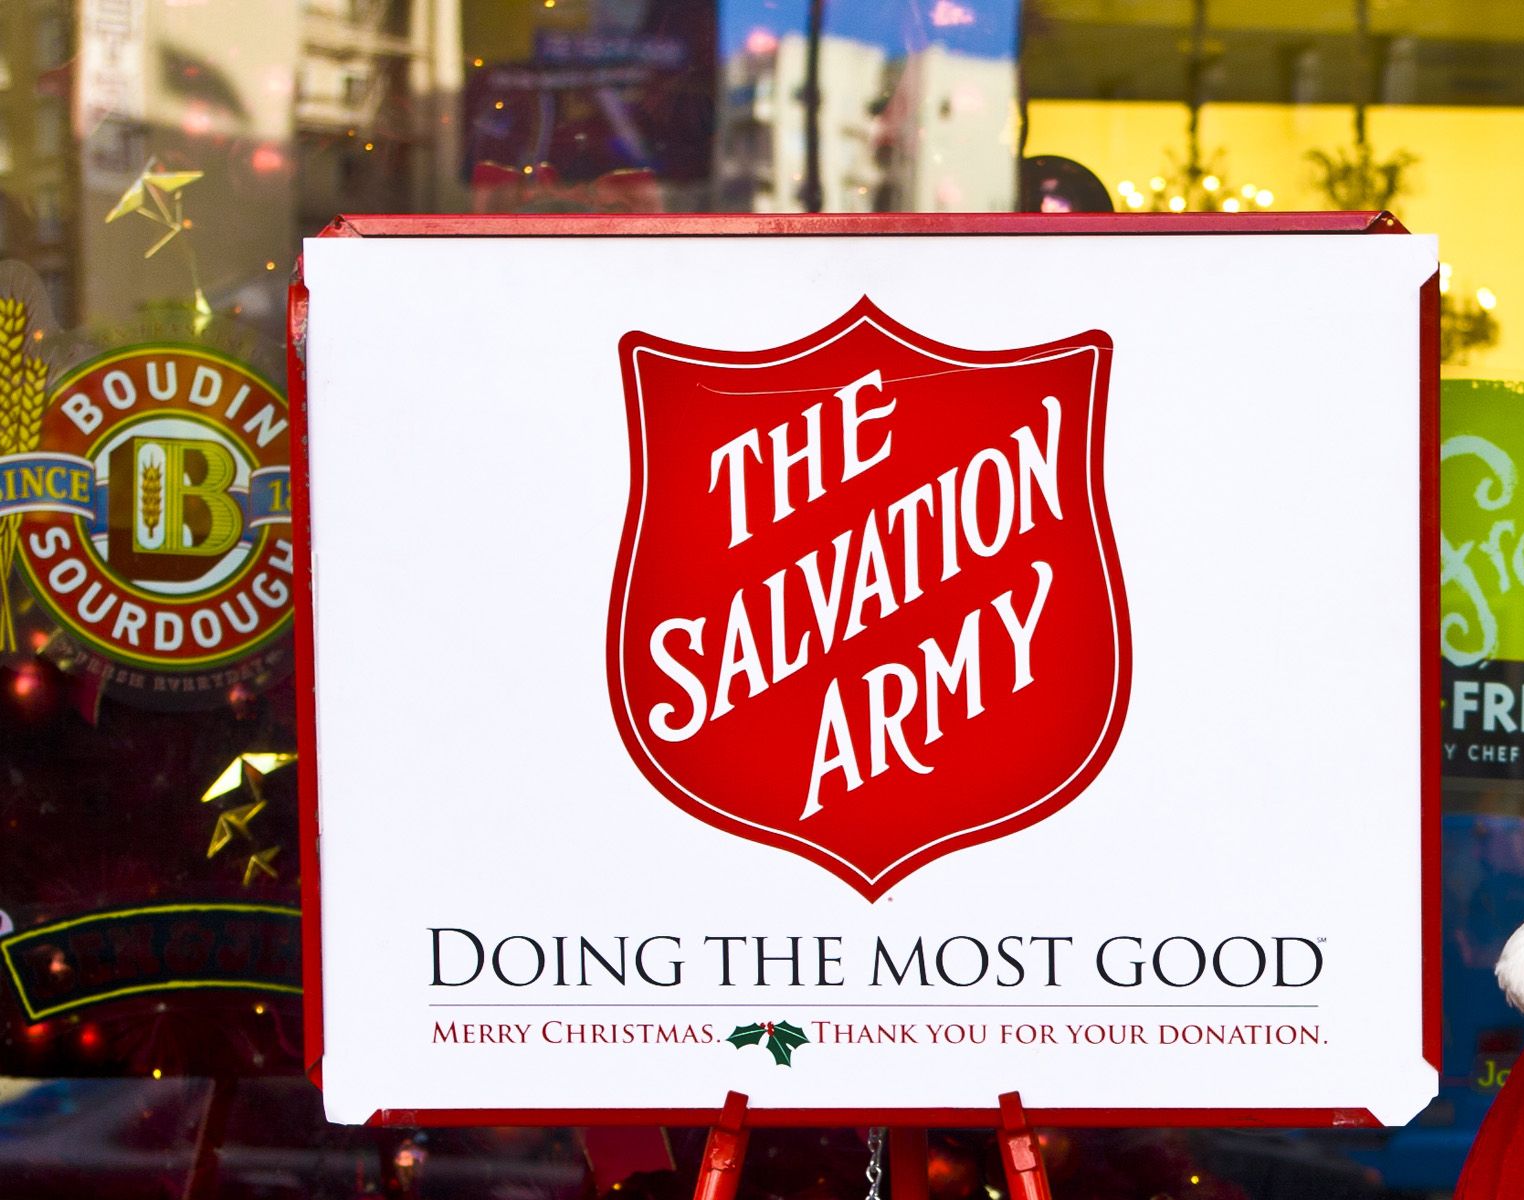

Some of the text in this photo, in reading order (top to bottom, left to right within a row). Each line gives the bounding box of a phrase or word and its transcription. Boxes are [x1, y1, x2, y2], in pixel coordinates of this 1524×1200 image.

[61, 361, 288, 448] BOUDIN
[0, 466, 90, 502] INCE
[709, 370, 896, 549] THE
[29, 527, 292, 650] SOURDOUGH
[648, 396, 1063, 741] SALVATION
[800, 561, 1053, 820] ARMY
[1468, 745, 1520, 762] CHEF
[426, 928, 685, 987] DOING
[704, 936, 845, 986] THE
[868, 936, 1073, 987] MOST
[432, 1020, 1328, 1045] MERRY CHRISTMAS. THANK YOU FOR YOUR DONATION.
